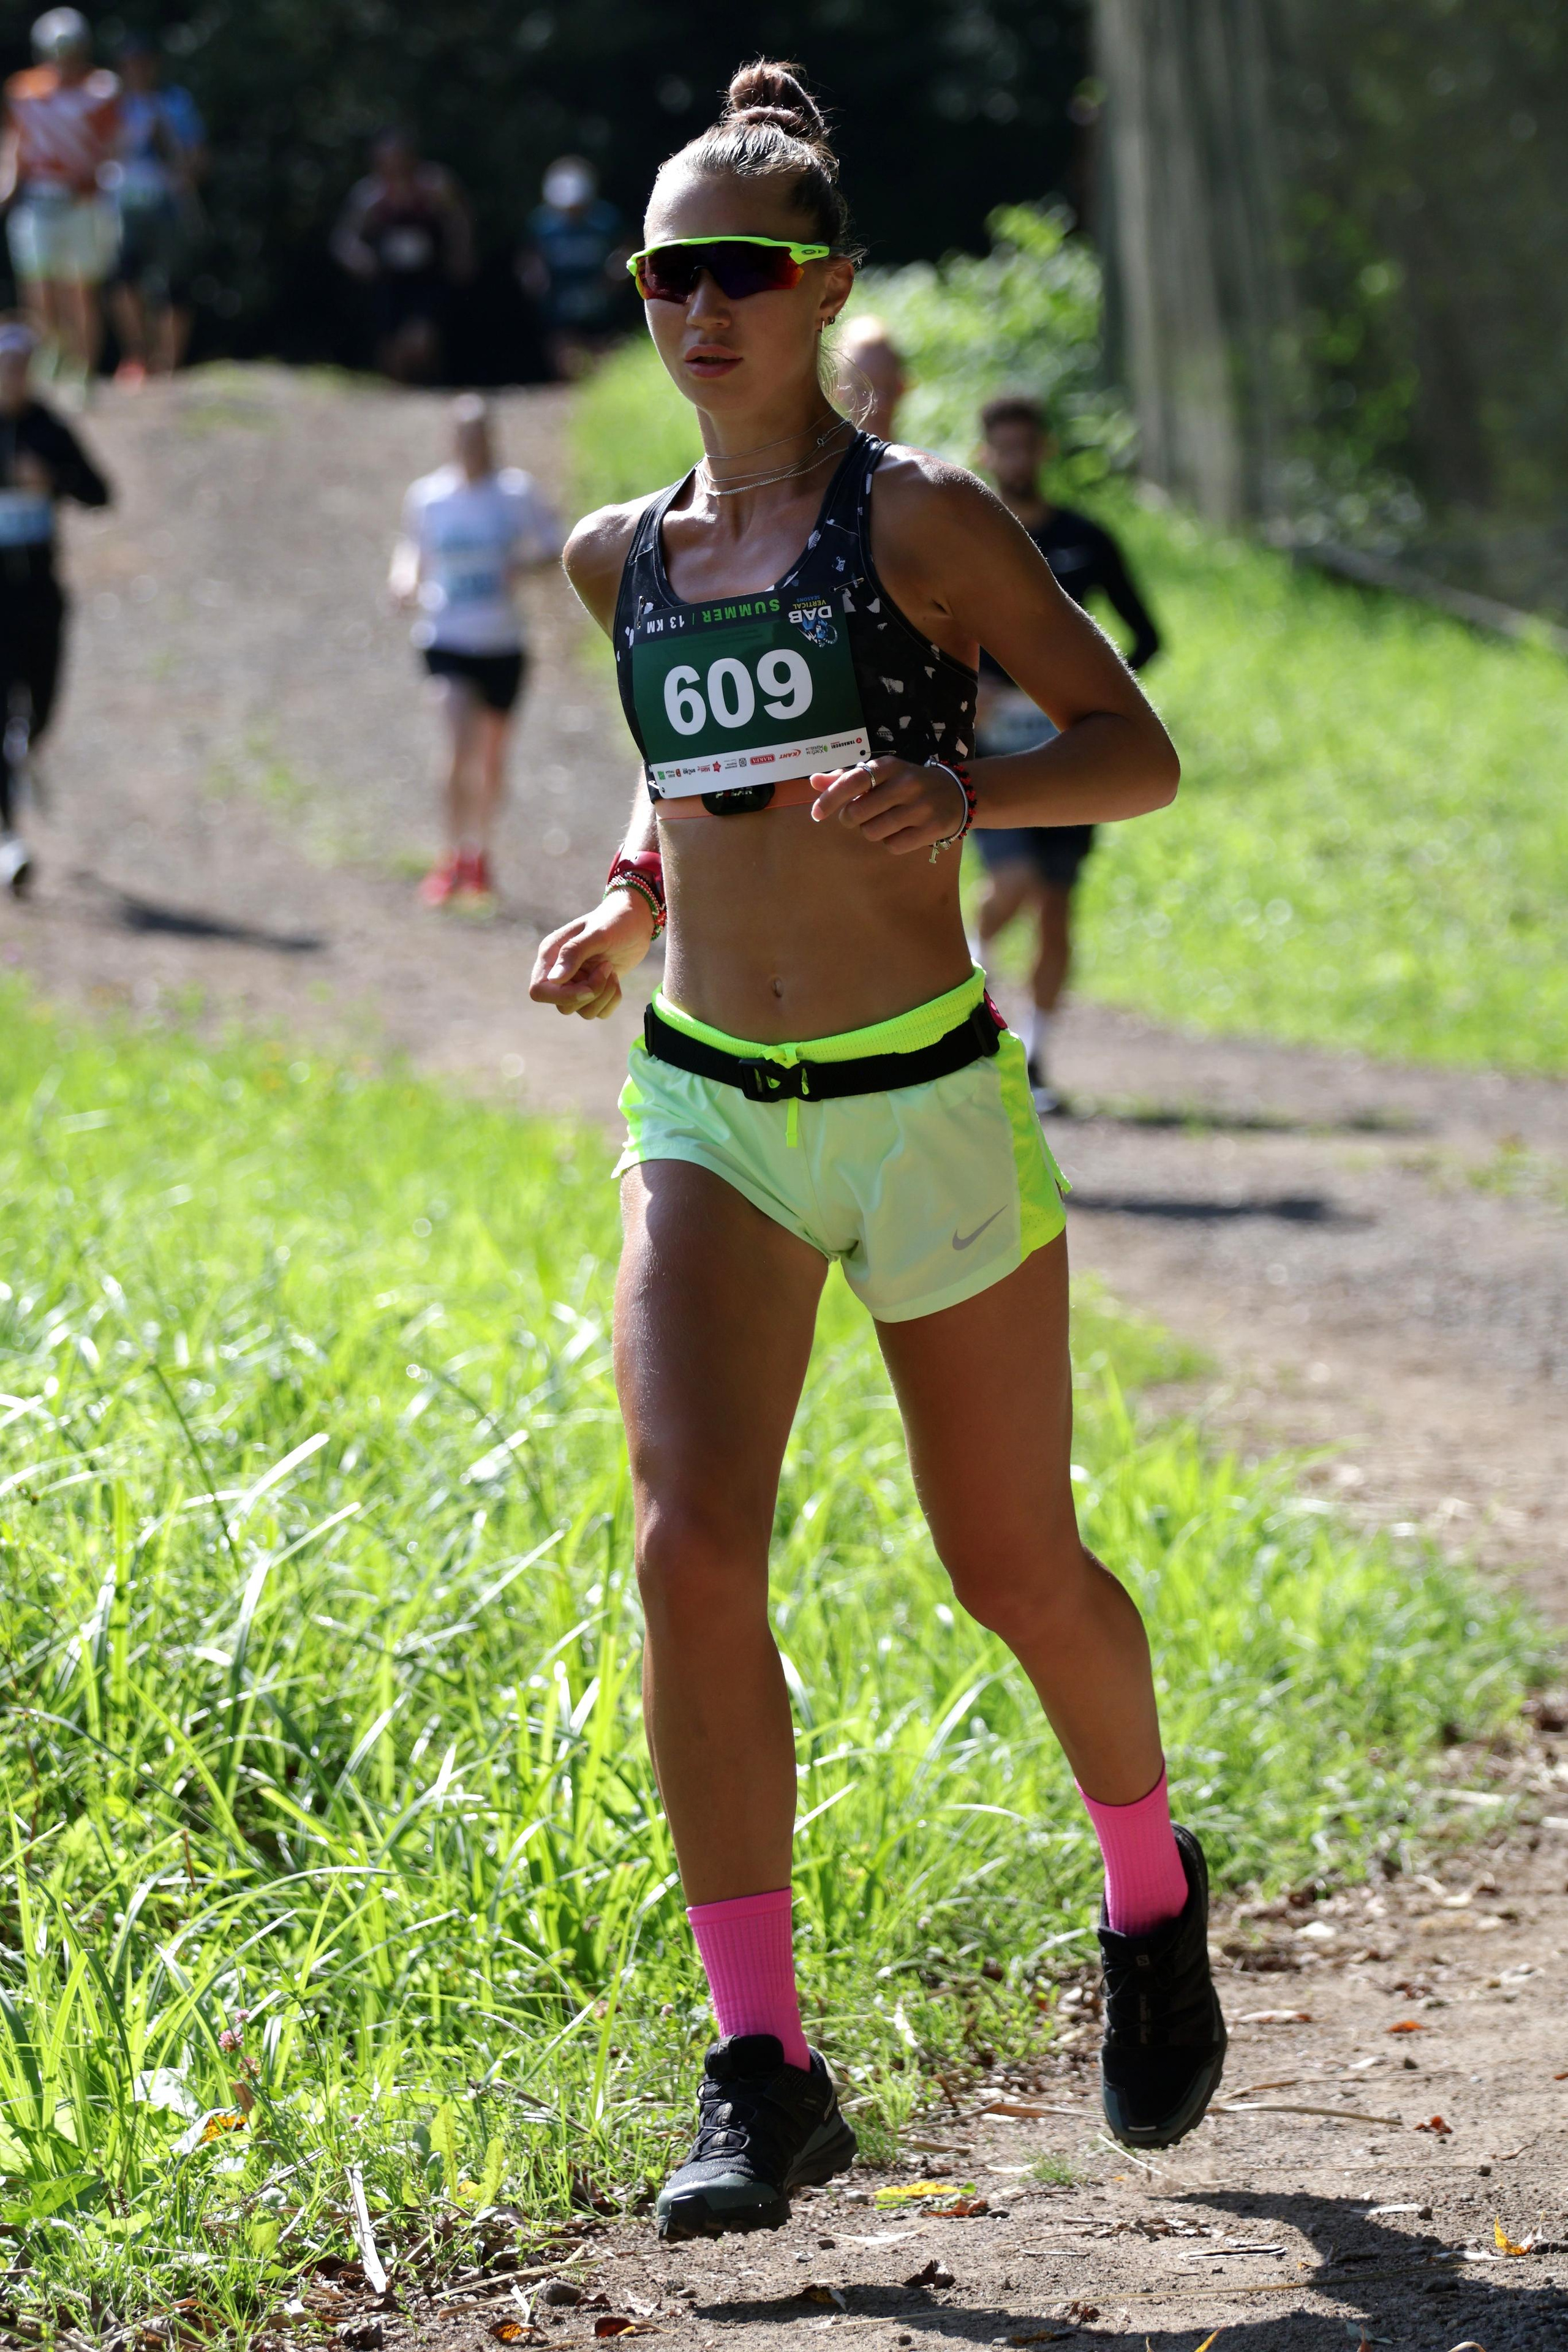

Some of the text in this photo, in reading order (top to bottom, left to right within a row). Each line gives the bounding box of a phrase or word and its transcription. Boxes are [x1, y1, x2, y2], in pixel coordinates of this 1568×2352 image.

[702, 599, 780, 622] SUMMER
[793, 600, 827, 609] VERTICAL
[669, 616, 685, 629] 13
[788, 605, 832, 624] DAB
[647, 619, 663, 634] KM
[664, 649, 813, 735] 609
